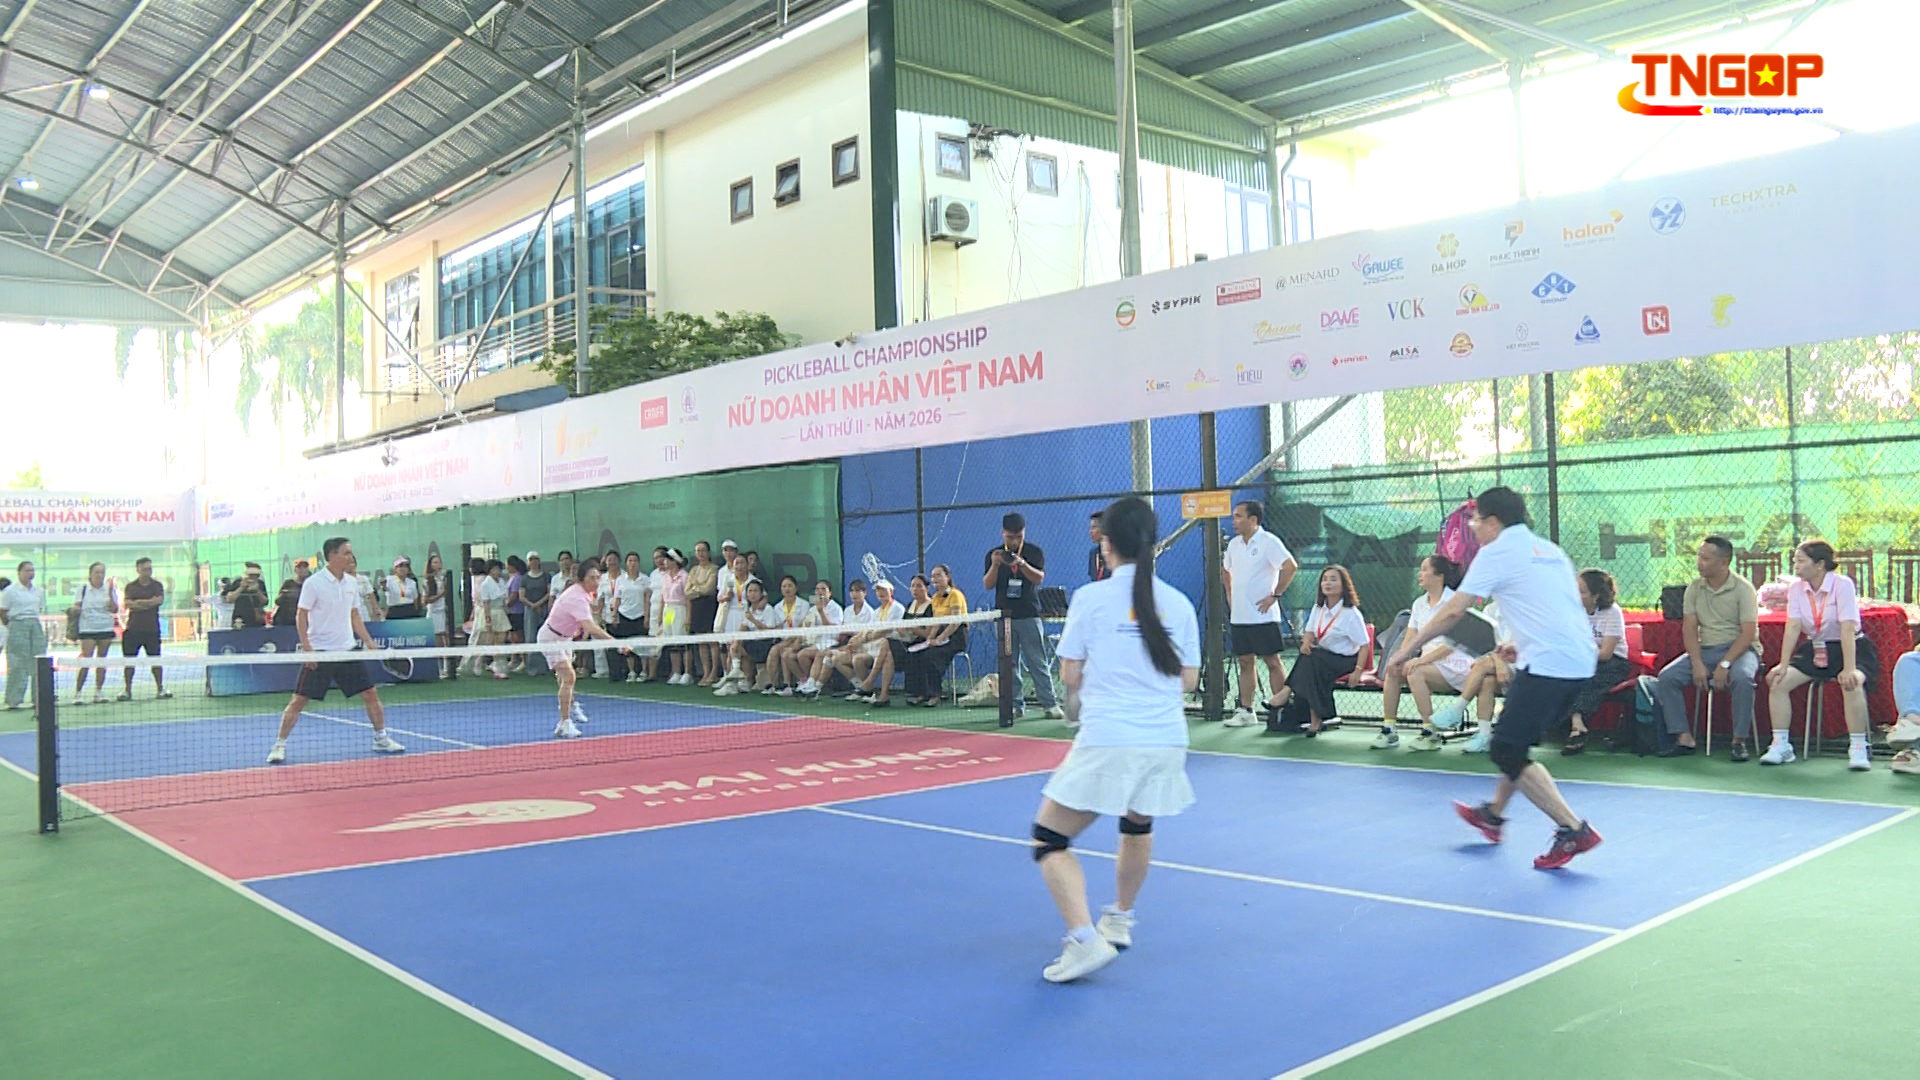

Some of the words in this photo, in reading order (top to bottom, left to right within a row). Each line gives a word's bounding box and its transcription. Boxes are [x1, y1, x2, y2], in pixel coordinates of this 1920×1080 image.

[1710, 183, 1797, 208] TECHXTRA
[1563, 223, 1615, 240] halan
[1289, 267, 1340, 286] MENARD
[1362, 257, 1404, 275] GAWEE
[1163, 294, 1202, 310] SYPIK
[1387, 297, 1426, 321] VCK
[764, 354, 850, 386] PICKLEBALL
[853, 326, 988, 369] CHAMPIONSHIP
[1390, 346, 1419, 358] MISA
[728, 394, 758, 428] NỮ
[760, 389, 836, 424] DOANH
[842, 370, 910, 410] NHÂN
[915, 358, 972, 404] VIỆT
[978, 350, 1044, 391] NAM
[800, 418, 824, 442] LẦN
[855, 419, 863, 435] II
[874, 411, 906, 430] NĂM
[909, 407, 942, 428] 2026
[367, 471, 397, 490] DOANH
[446, 455, 469, 476] NAM
[47, 498, 143, 508] CHAMPIONSHIP
[136, 511, 175, 523] NAM
[90, 526, 113, 534] 2026
[579, 771, 769, 799] THAI
[644, 770, 899, 807] PICKLEBALL
